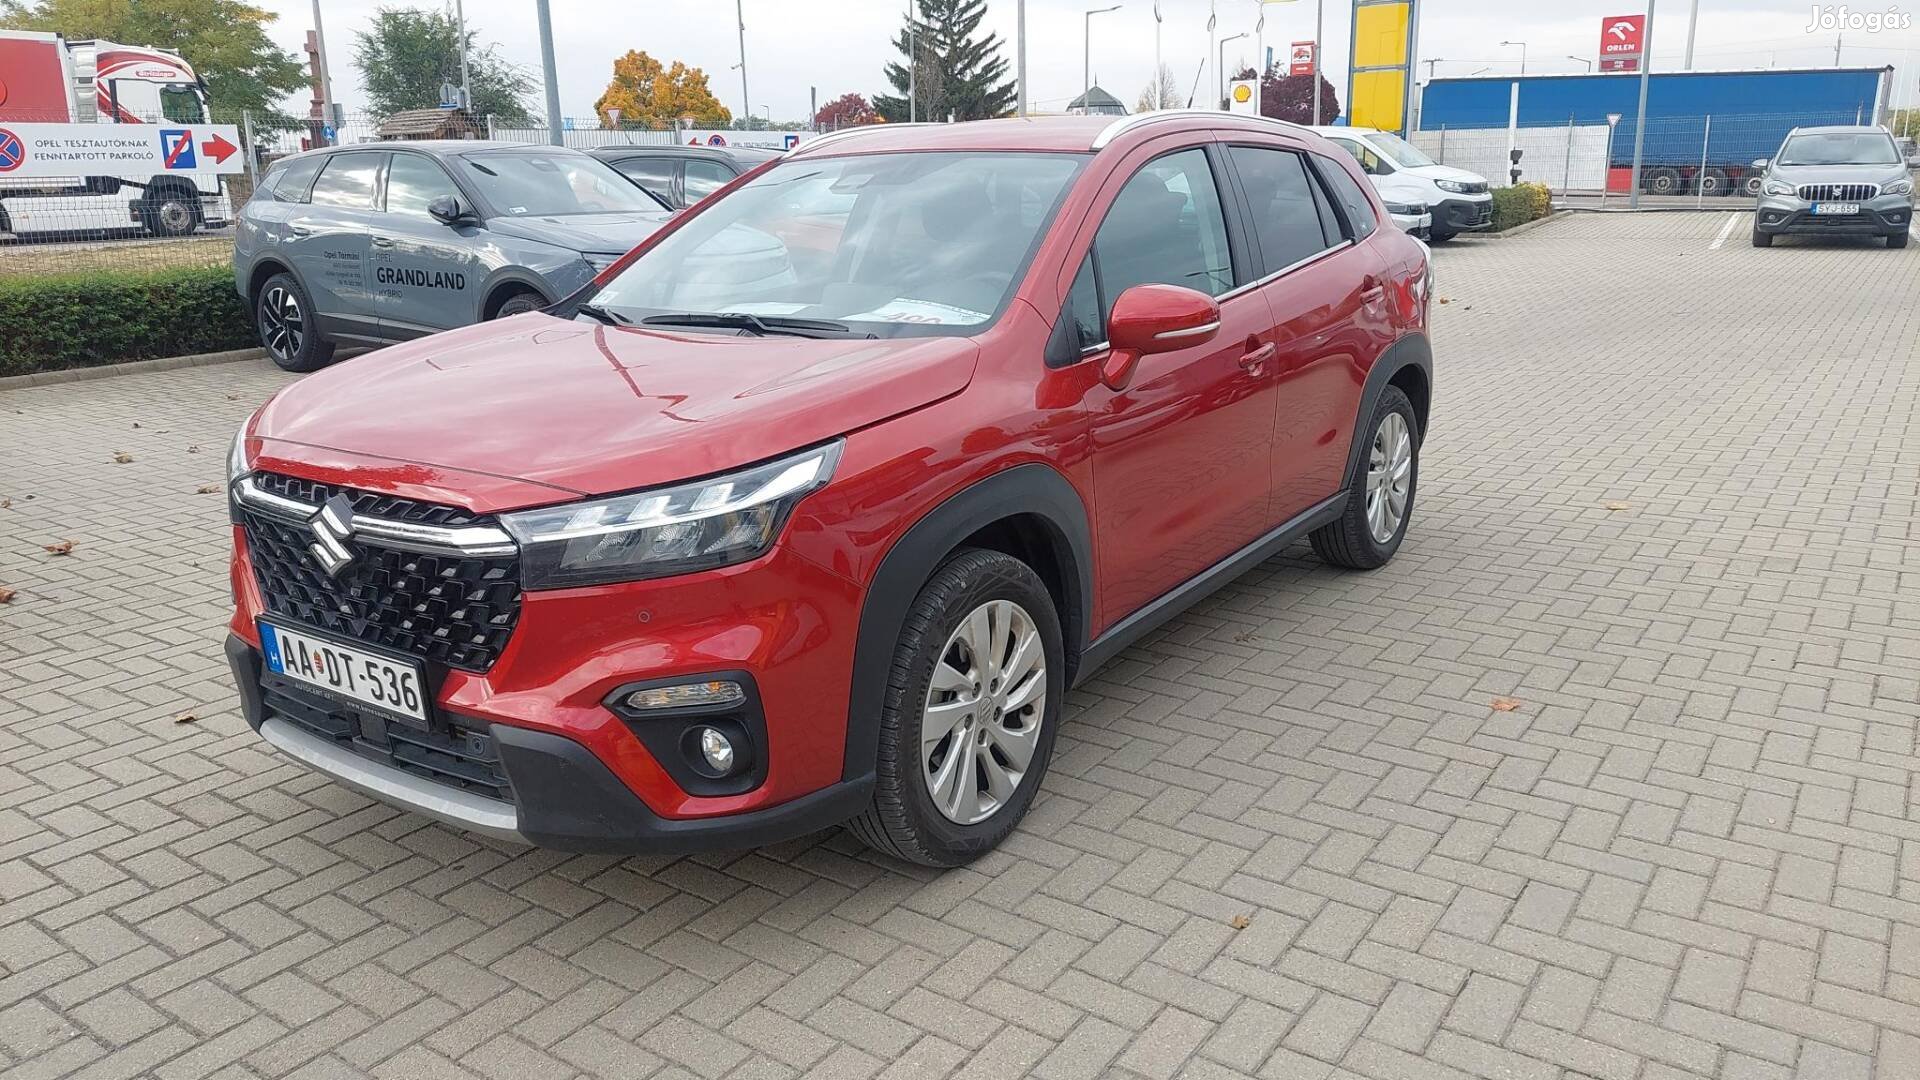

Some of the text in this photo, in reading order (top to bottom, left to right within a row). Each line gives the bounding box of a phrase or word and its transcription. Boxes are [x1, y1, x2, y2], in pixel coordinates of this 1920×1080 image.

[1606, 43, 1635, 52] ORLEN
[35, 138, 149, 148] OPEL TESZTAUTÓKNAK
[34, 151, 154, 161] FENNTARTOTT PARKOLÓ
[375, 252, 393, 263] OPEL
[376, 266, 466, 290] GRANDLAND
[378, 288, 402, 298] HYBRID
